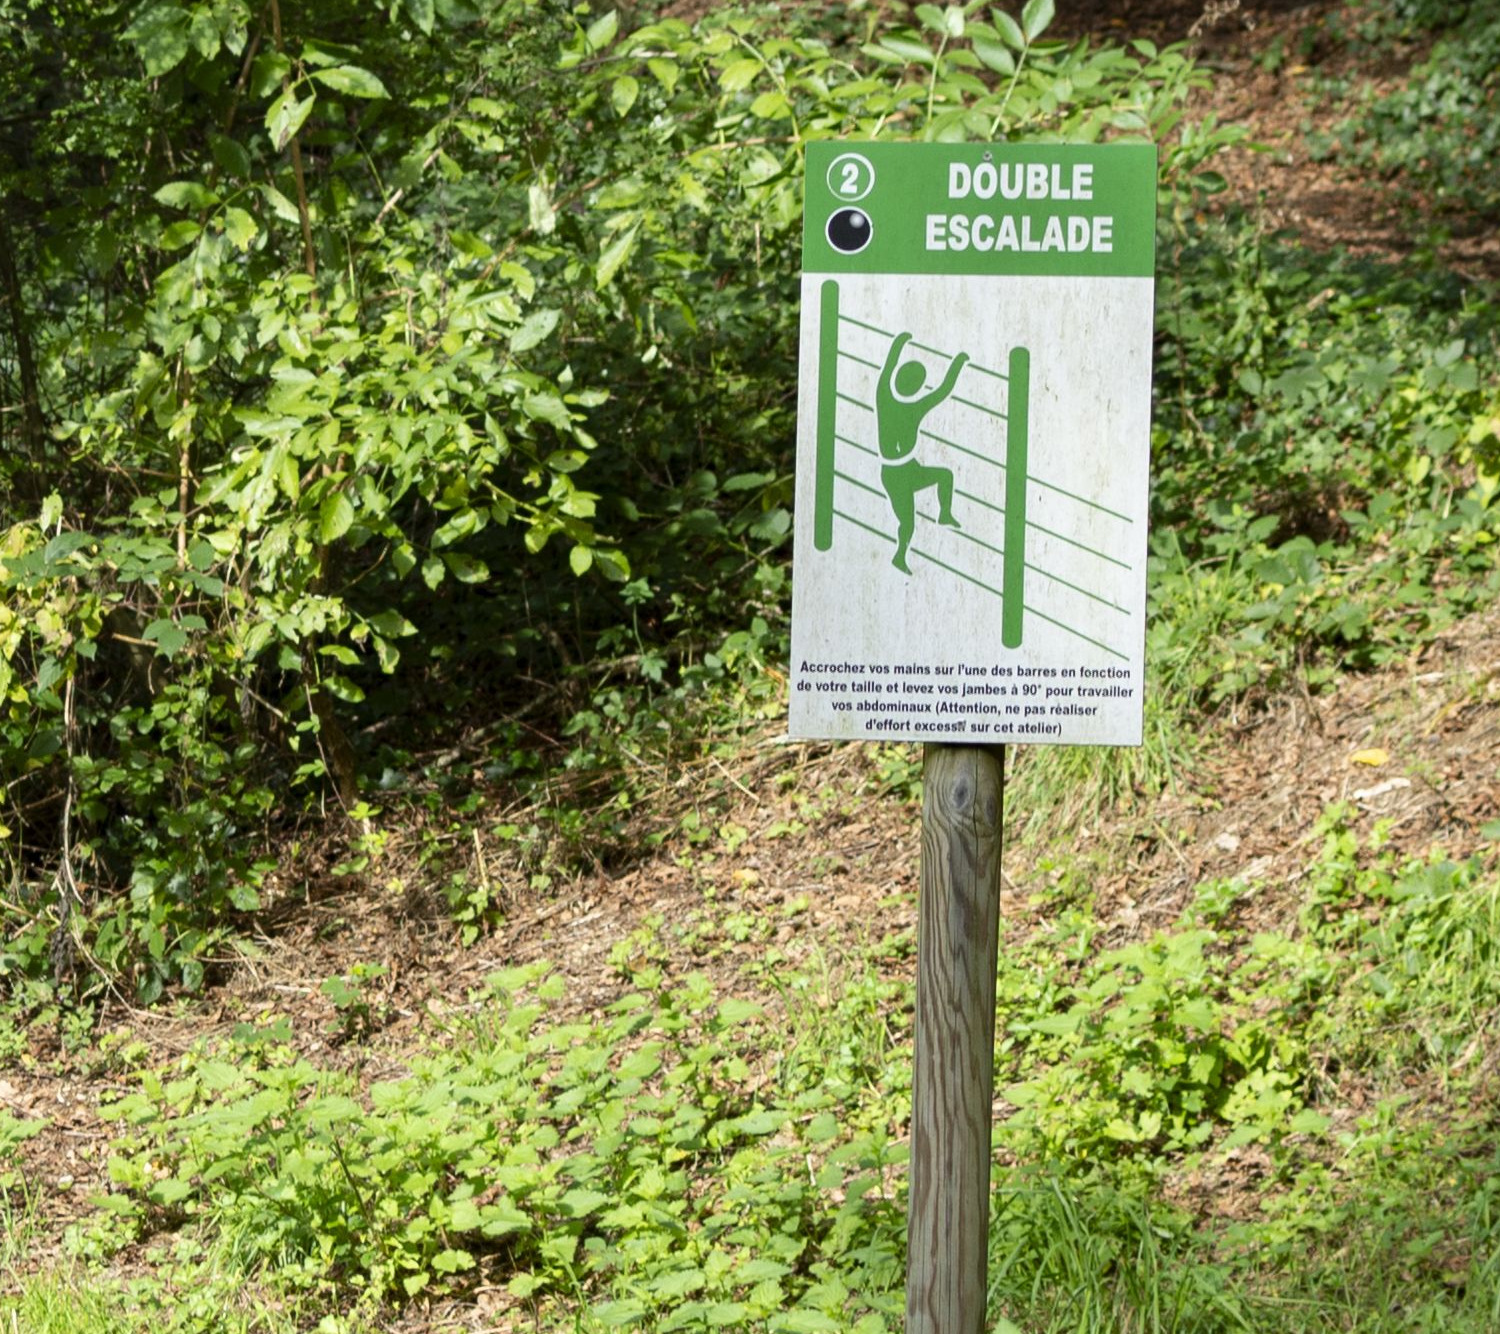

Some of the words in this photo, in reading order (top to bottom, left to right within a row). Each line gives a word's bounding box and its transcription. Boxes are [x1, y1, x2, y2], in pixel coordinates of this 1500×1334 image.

[839, 162, 859, 194] 2
[948, 161, 1093, 200] DOUBLE
[925, 214, 1113, 253] ESCALADE
[800, 661, 865, 674] Accrochez
[869, 664, 890, 674] vos
[893, 663, 931, 676] mains
[934, 665, 954, 676] sur
[958, 664, 987, 676] l'une
[991, 665, 1013, 677] des
[1017, 665, 1057, 678] barres
[1061, 667, 1076, 678] en
[1080, 667, 1131, 679] fonction
[796, 680, 811, 691] de
[815, 681, 847, 692] votre
[851, 681, 882, 693] taille
[886, 682, 899, 693] et
[902, 682, 934, 694] levez
[938, 684, 958, 694] vos
[961, 683, 1007, 696] jambes
[1045, 686, 1073, 699] pour
[1077, 686, 1134, 698] travailler
[831, 701, 852, 711] vos
[856, 700, 931, 713] abdominaux
[935, 701, 1001, 717] (Attention,
[1005, 705, 1020, 714] ne
[1024, 705, 1046, 717] pas
[1049, 703, 1098, 716] réaliser
[865, 718, 911, 731] d'effort
[970, 723, 990, 734] sur
[993, 721, 1014, 734] cet
[1017, 722, 1063, 737] atelier)
